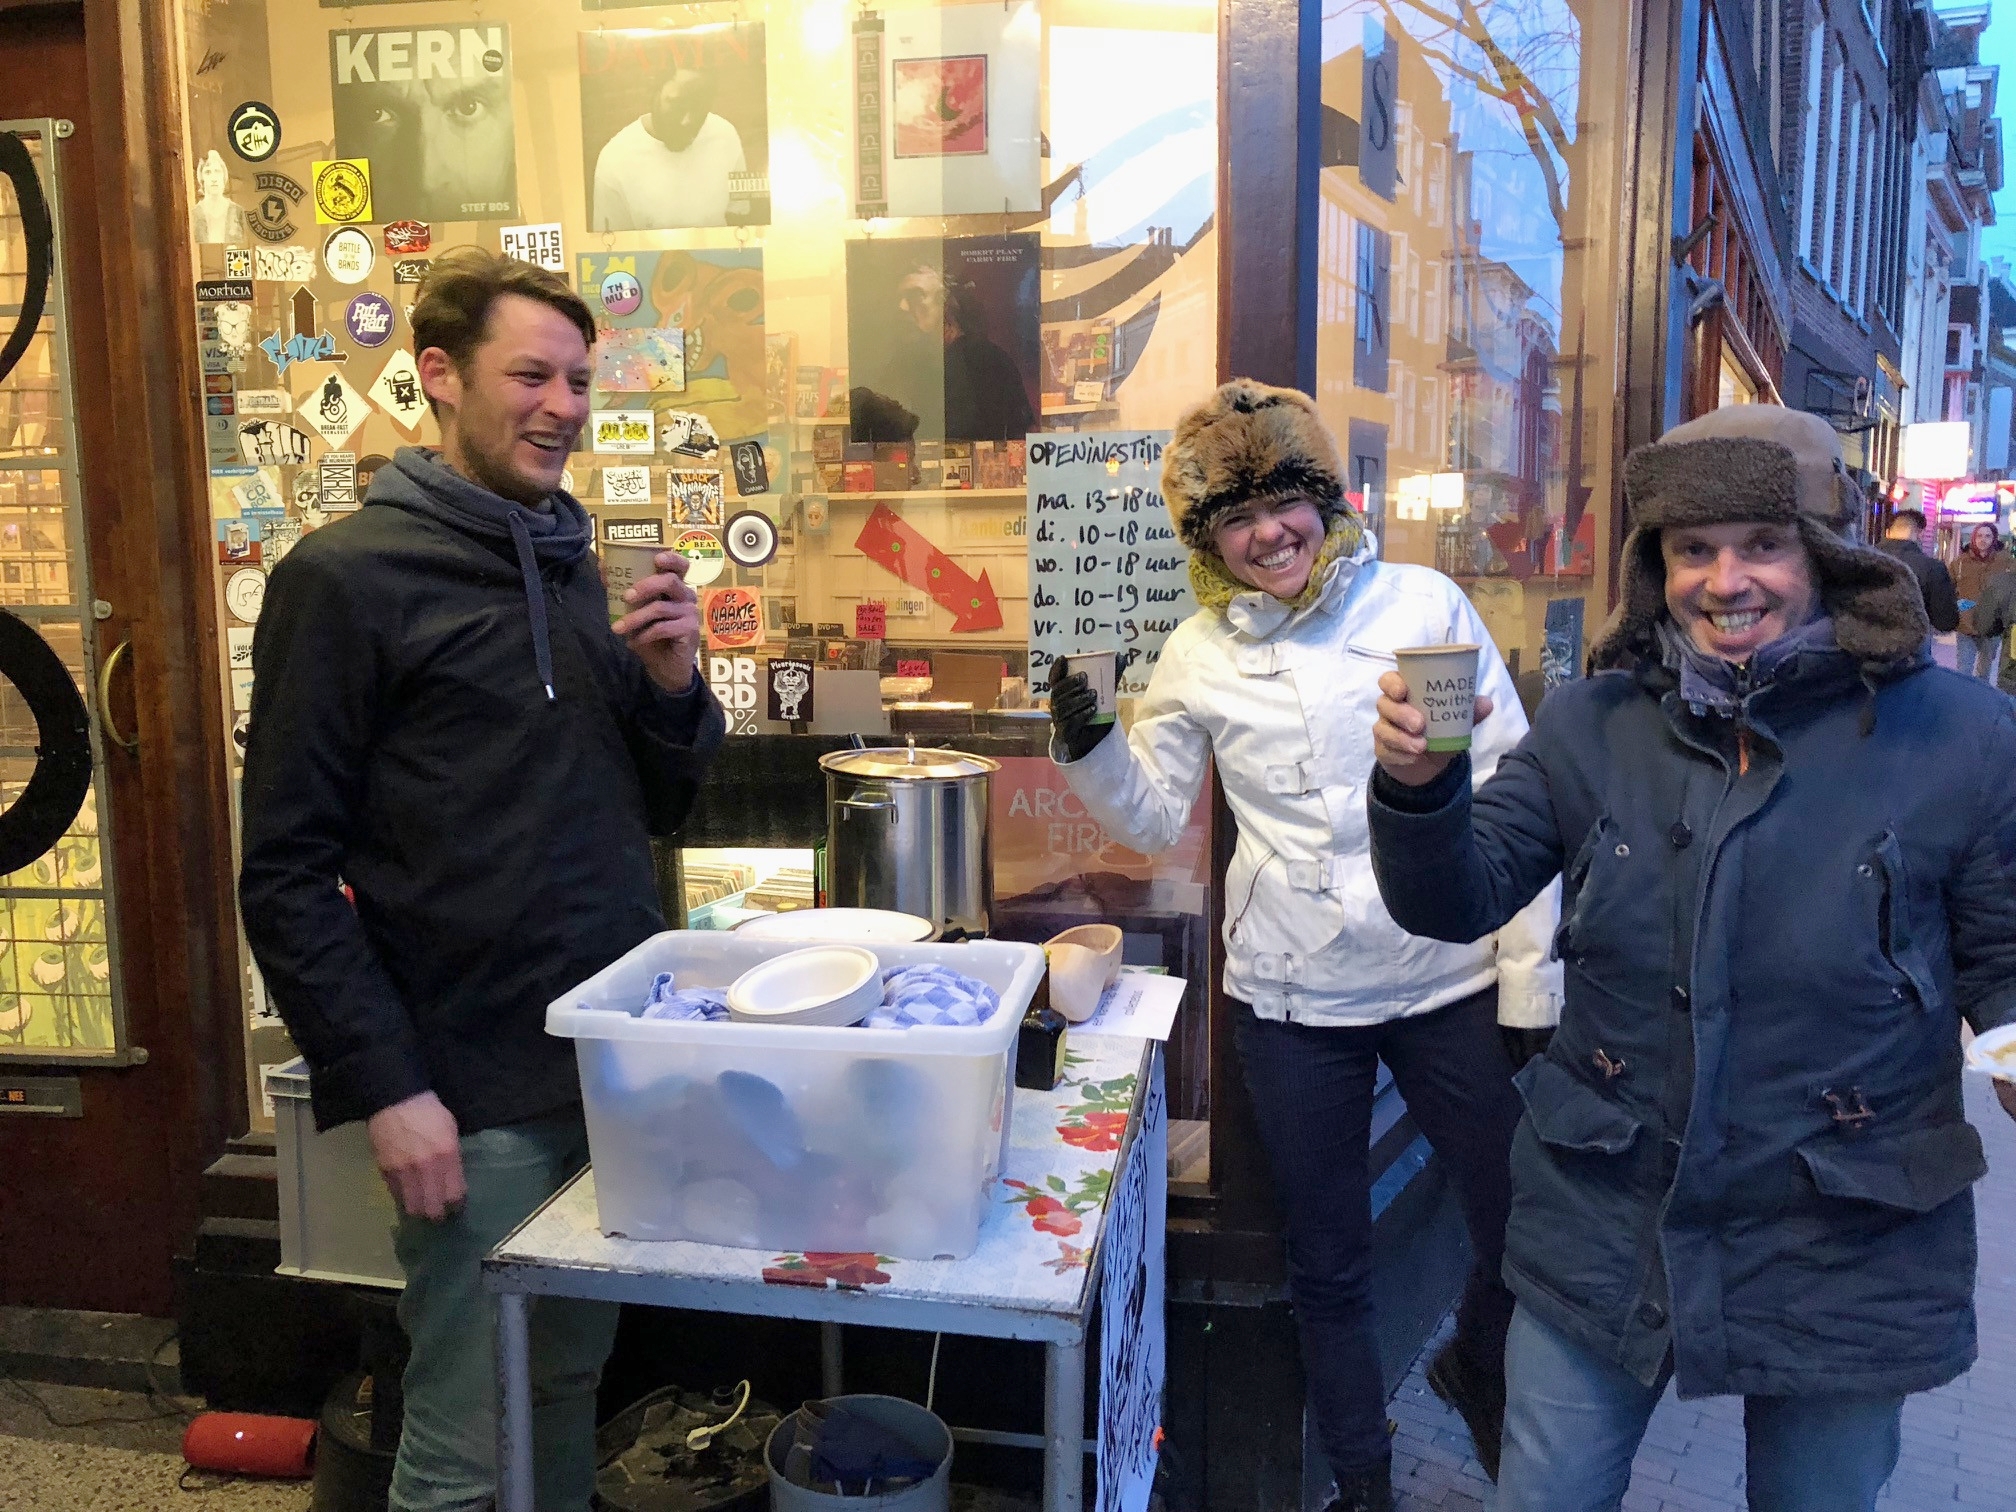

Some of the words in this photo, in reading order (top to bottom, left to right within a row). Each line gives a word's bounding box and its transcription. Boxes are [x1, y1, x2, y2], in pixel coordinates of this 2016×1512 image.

[336, 27, 503, 84] KERN
[259, 176, 301, 199] DISCO
[461, 203, 486, 213] STEF
[489, 202, 510, 212] BOS
[249, 213, 292, 239] BISCUITS
[339, 242, 360, 253] BATTLE
[505, 230, 560, 250] PLOTS
[507, 248, 561, 264] APS
[960, 249, 993, 257] ROBERT
[996, 248, 1023, 256] PLANT
[228, 263, 251, 277] FEST!
[338, 260, 360, 270] BANDS
[199, 283, 251, 297] MORTICIA
[607, 281, 629, 293] THE
[605, 288, 638, 304] MUDD
[352, 303, 381, 321] Riff
[356, 313, 389, 335] Raff
[681, 474, 709, 483] BLACK
[246, 485, 265, 501] CD
[251, 494, 271, 508] BON
[1037, 493, 1075, 514] ma.
[1086, 487, 1143, 513] 13-18
[608, 523, 658, 540] REGGAE
[1037, 519, 1064, 542] di.
[1079, 520, 1139, 545] 10-18
[1036, 558, 1063, 573] wo.
[1076, 552, 1140, 576] 10-18
[1145, 556, 1185, 571] uur
[725, 594, 737, 603] DE
[1034, 584, 1059, 608] do.
[1075, 584, 1138, 613] 10-19
[1146, 587, 1185, 602] uur
[712, 602, 756, 622] NAAKTE
[713, 620, 758, 635] WAARHEID
[1034, 619, 1062, 637] vr.
[1075, 617, 1139, 642] 10-19
[710, 657, 756, 683] DR
[1426, 677, 1475, 692] MADE
[1008, 788, 1100, 818] ARC
